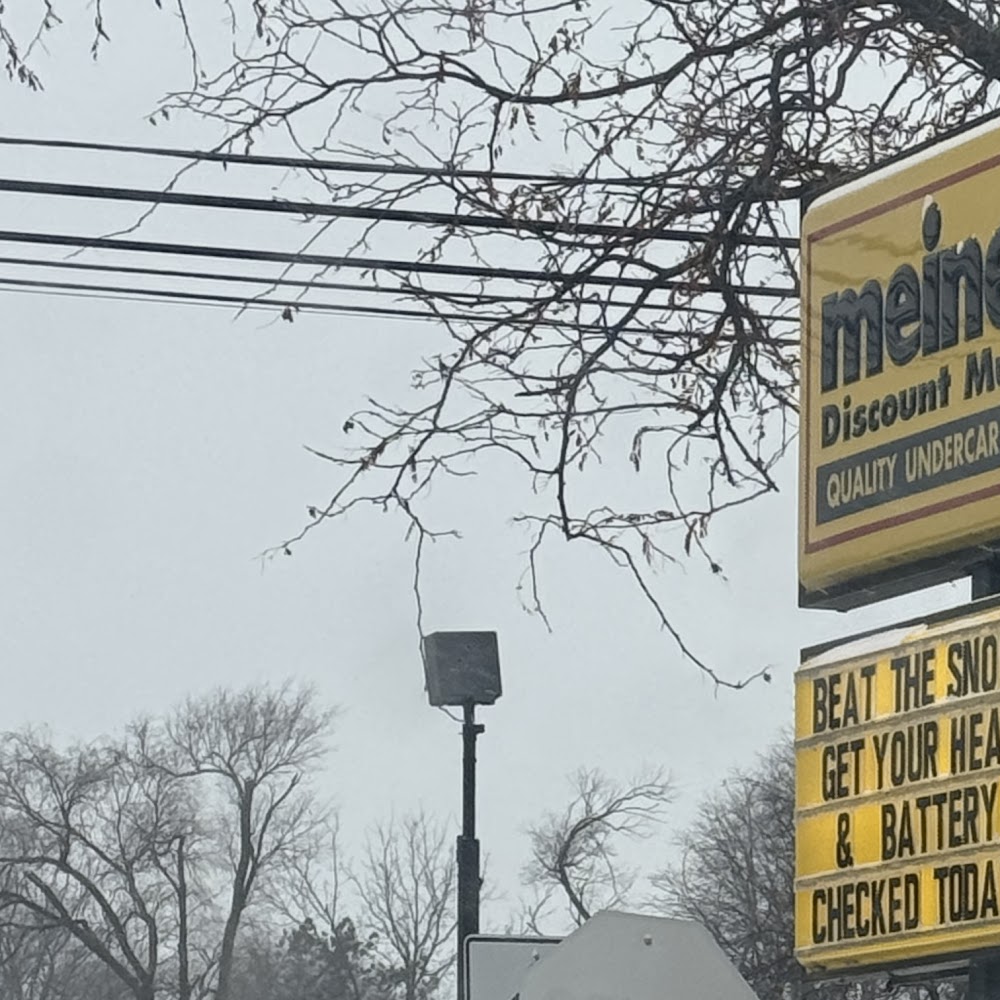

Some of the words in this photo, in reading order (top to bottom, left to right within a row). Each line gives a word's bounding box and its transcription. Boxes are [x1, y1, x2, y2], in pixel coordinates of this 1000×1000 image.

[821, 366, 952, 449] Discount
[826, 452, 898, 508] QUALITY
[905, 421, 999, 482] UNDERCAR
[813, 665, 876, 734] BEAT
[890, 650, 936, 713] THE
[822, 739, 865, 801] GET
[873, 720, 938, 789] YOUR
[836, 812, 854, 868] &
[881, 783, 998, 861] BATTERY
[812, 872, 920, 945] CHECKED
